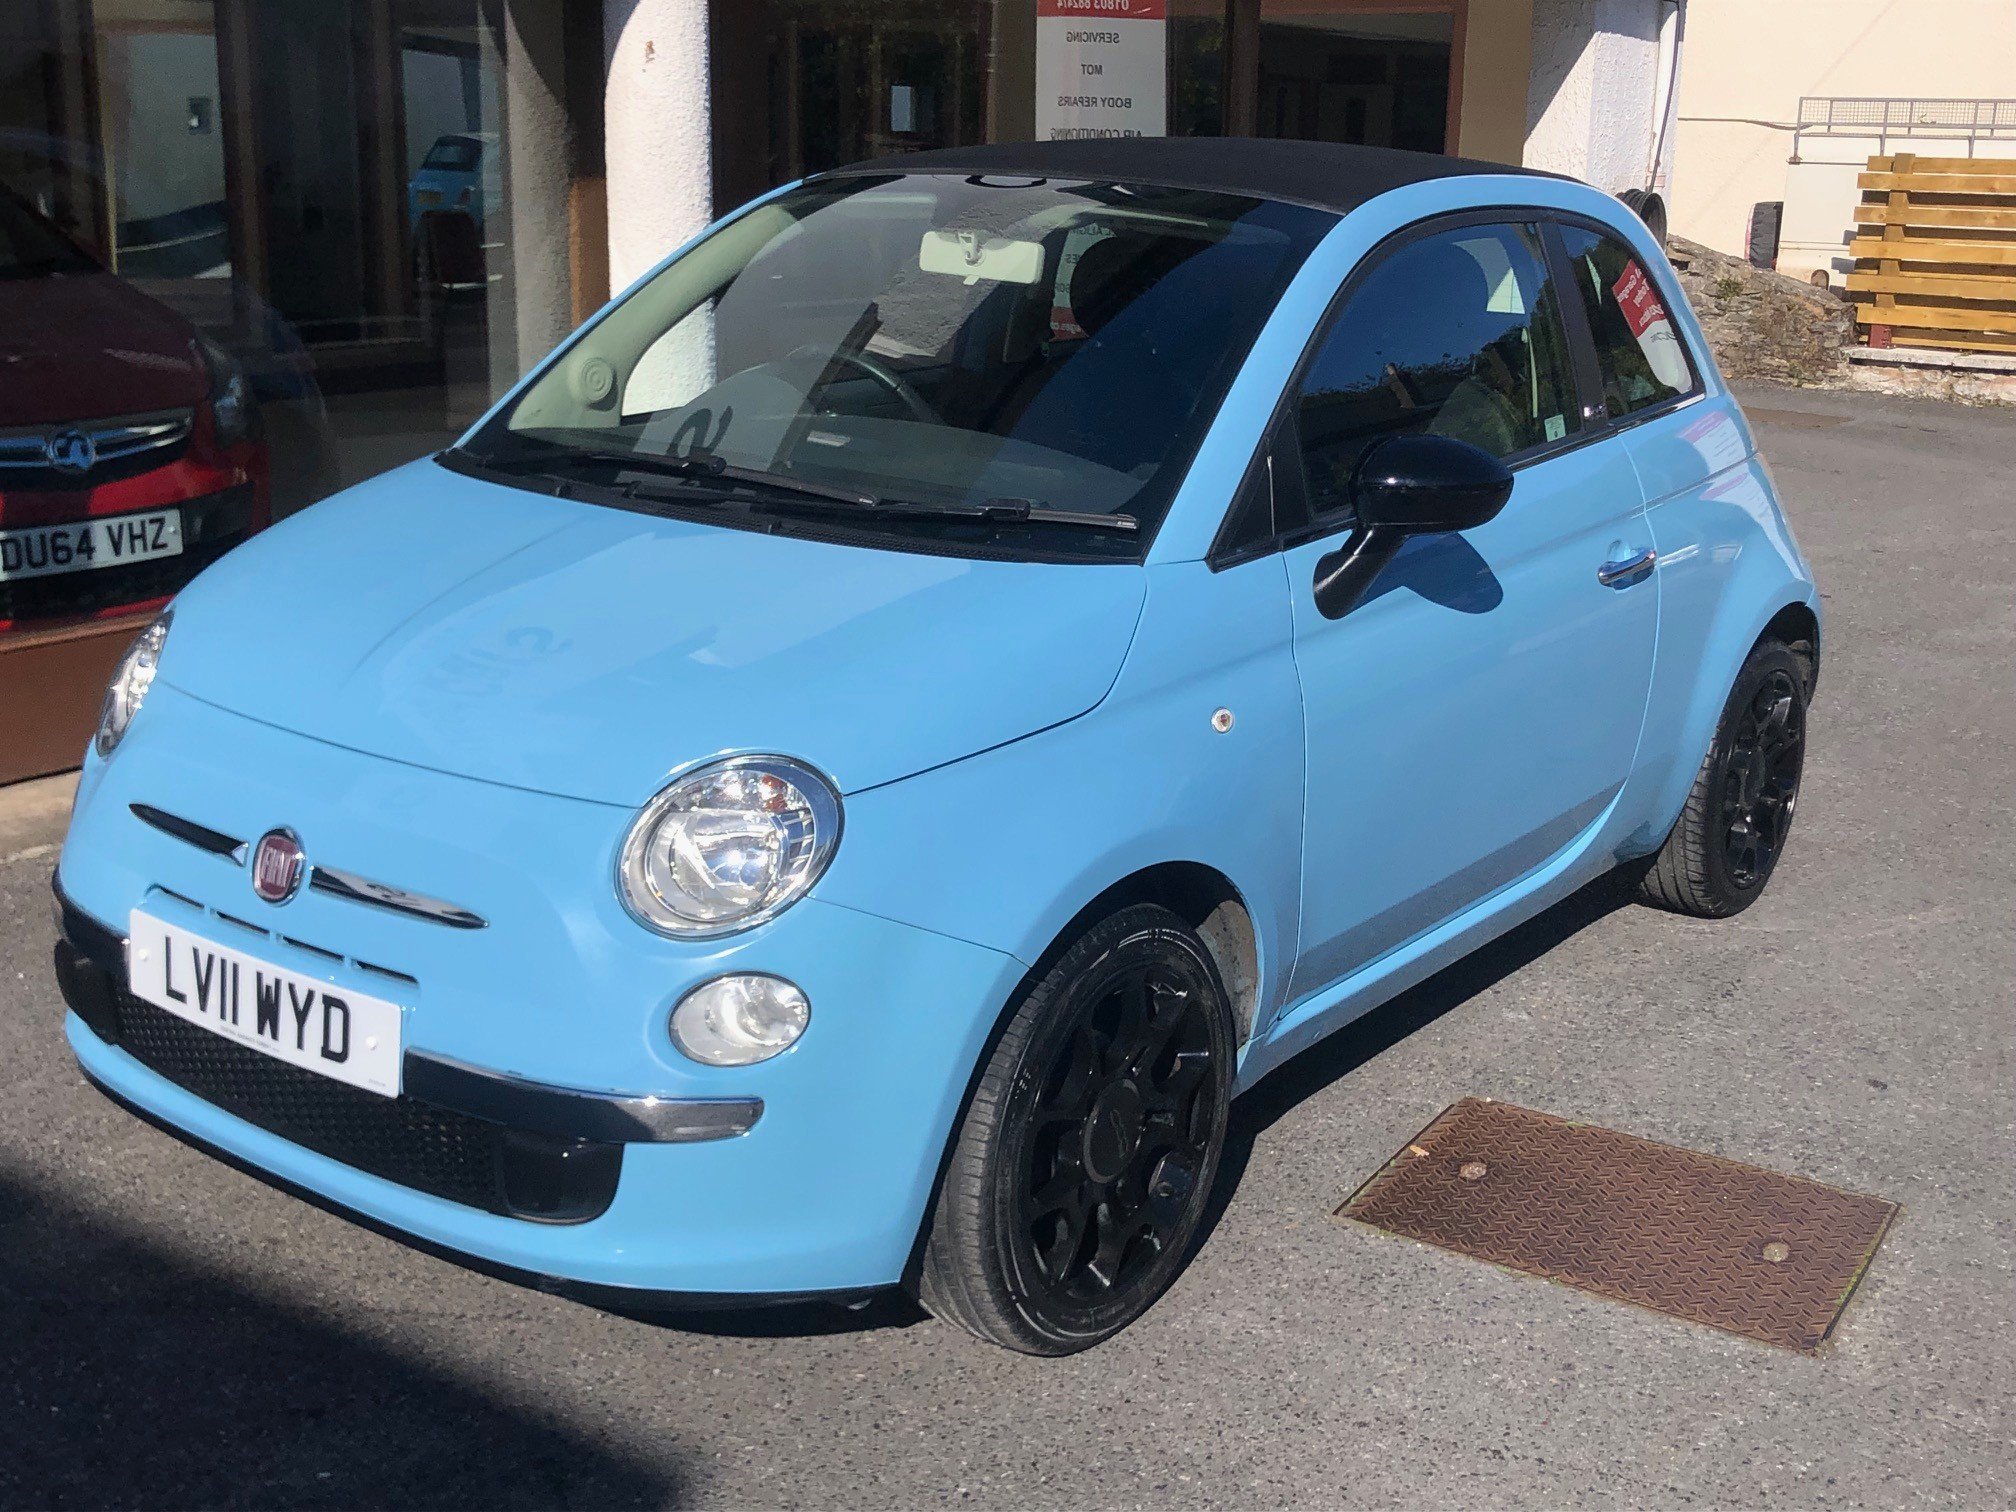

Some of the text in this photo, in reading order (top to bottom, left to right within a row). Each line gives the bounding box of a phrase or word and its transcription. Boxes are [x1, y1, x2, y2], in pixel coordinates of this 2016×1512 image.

[1, 517, 169, 572] DU64 VHZ
[165, 936, 351, 1064] LV11 WYD
